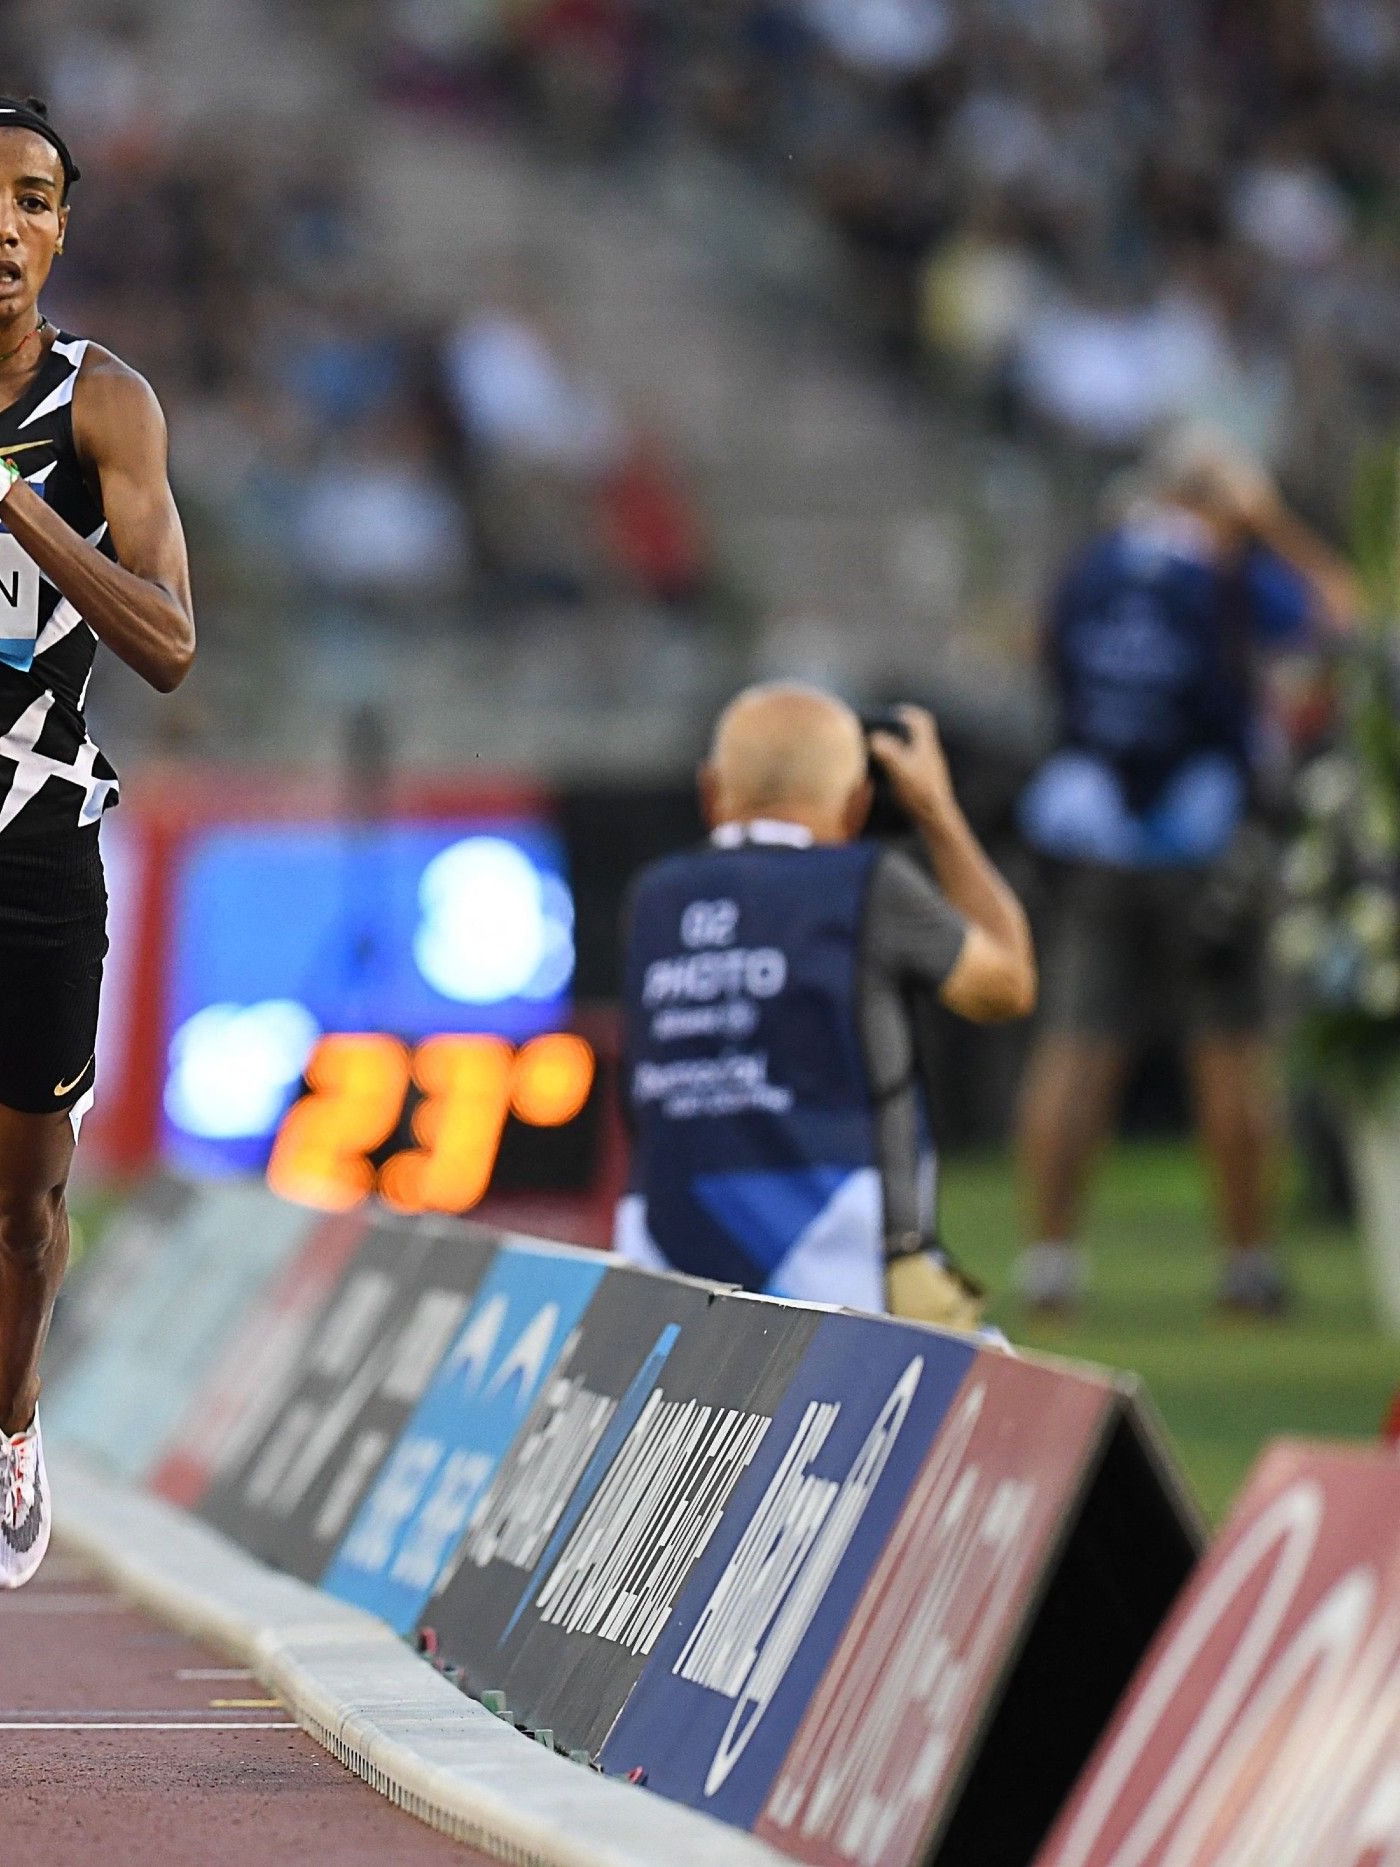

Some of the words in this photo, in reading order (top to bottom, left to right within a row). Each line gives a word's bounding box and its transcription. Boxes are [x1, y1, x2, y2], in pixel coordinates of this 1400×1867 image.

[643, 948, 787, 1006] PHOTO
[536, 1387, 712, 1634] DIAMOND
[598, 1407, 773, 1656] LEAGUE
[672, 1401, 841, 1698] Allianz
